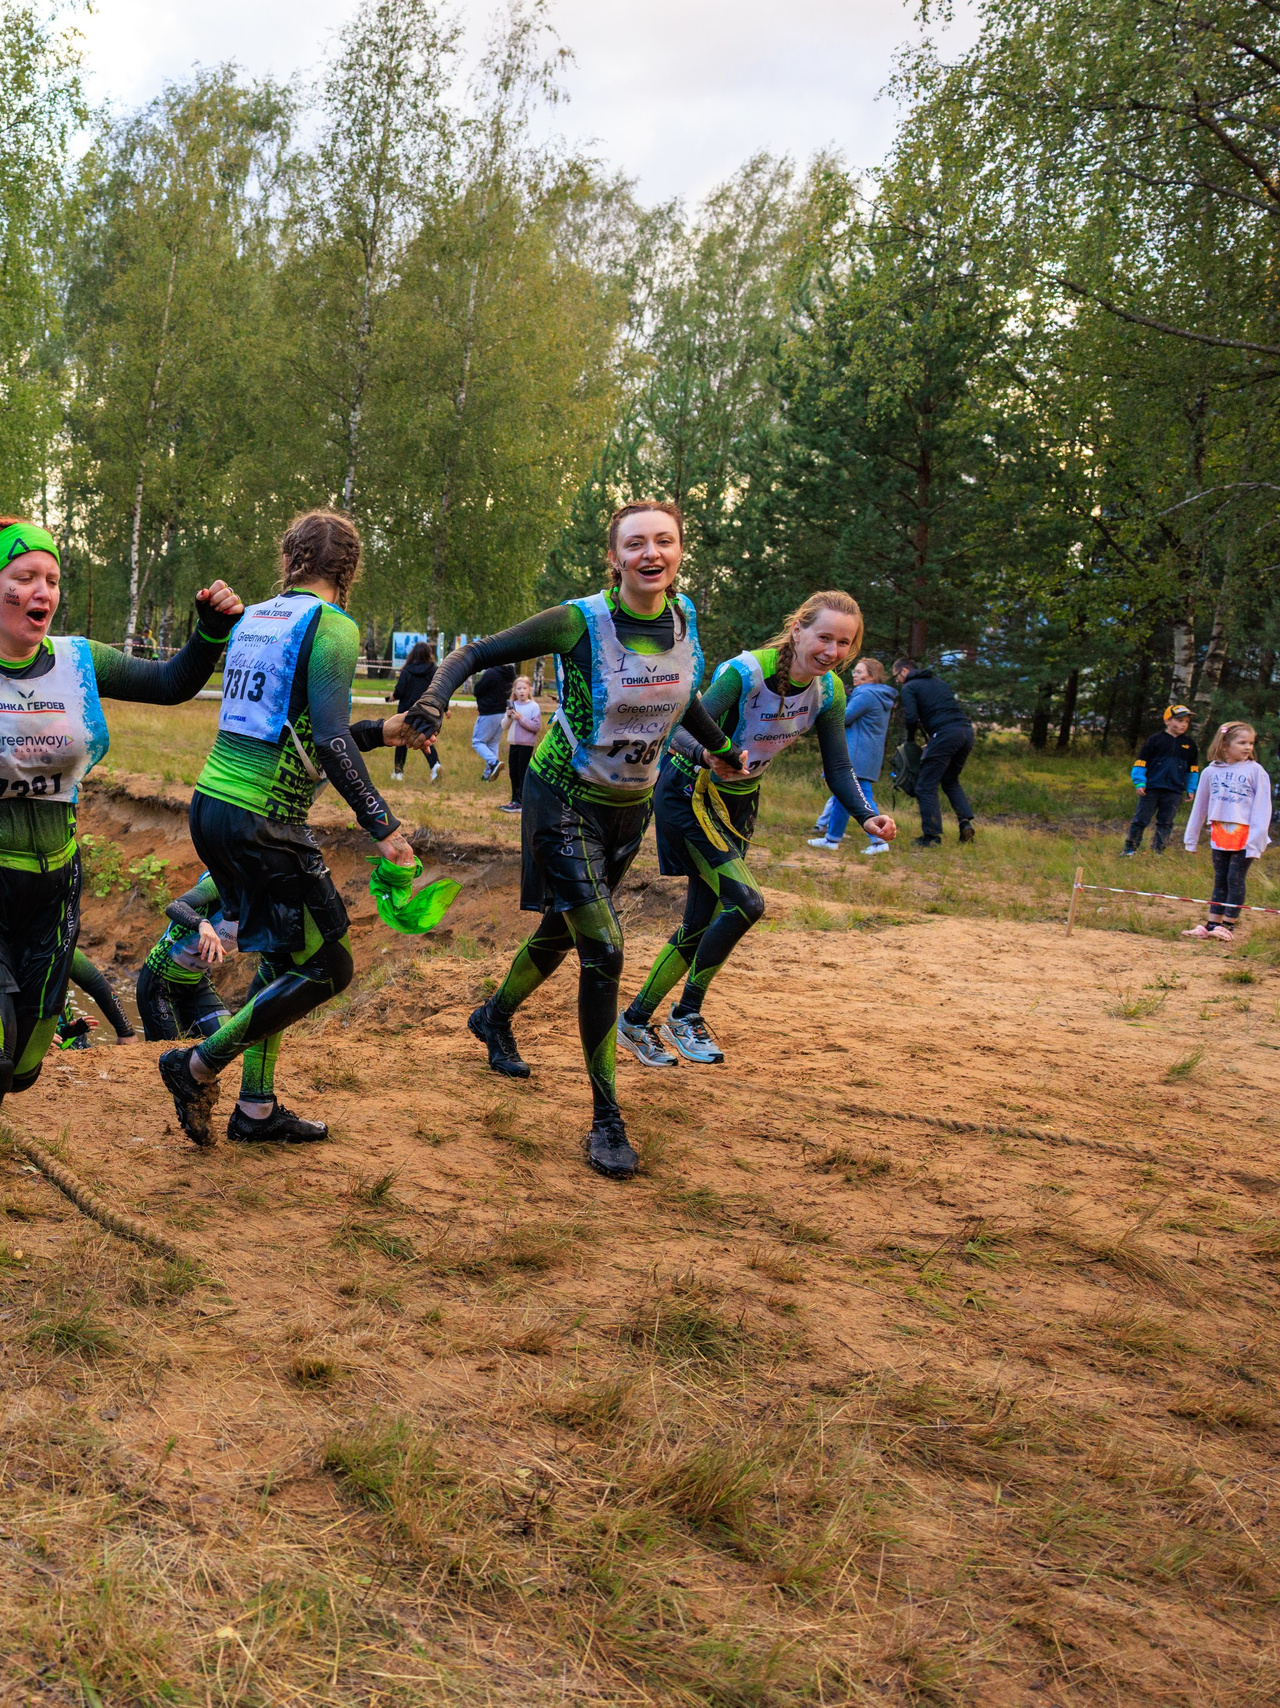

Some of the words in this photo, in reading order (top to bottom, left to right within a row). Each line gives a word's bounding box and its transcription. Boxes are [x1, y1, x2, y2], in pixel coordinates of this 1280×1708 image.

[237, 631, 273, 646] Greenway
[614, 653, 629, 674] 1
[223, 669, 267, 703] 7313
[621, 676, 650, 685] ГОНКА
[651, 673, 680, 683] ГЕРОЕВ
[27, 701, 66, 711] ГЕРОЕВ
[751, 691, 761, 709] 1
[617, 702, 678, 714] Greenway
[329, 737, 386, 816] Greenway
[219, 927, 238, 941] Green
